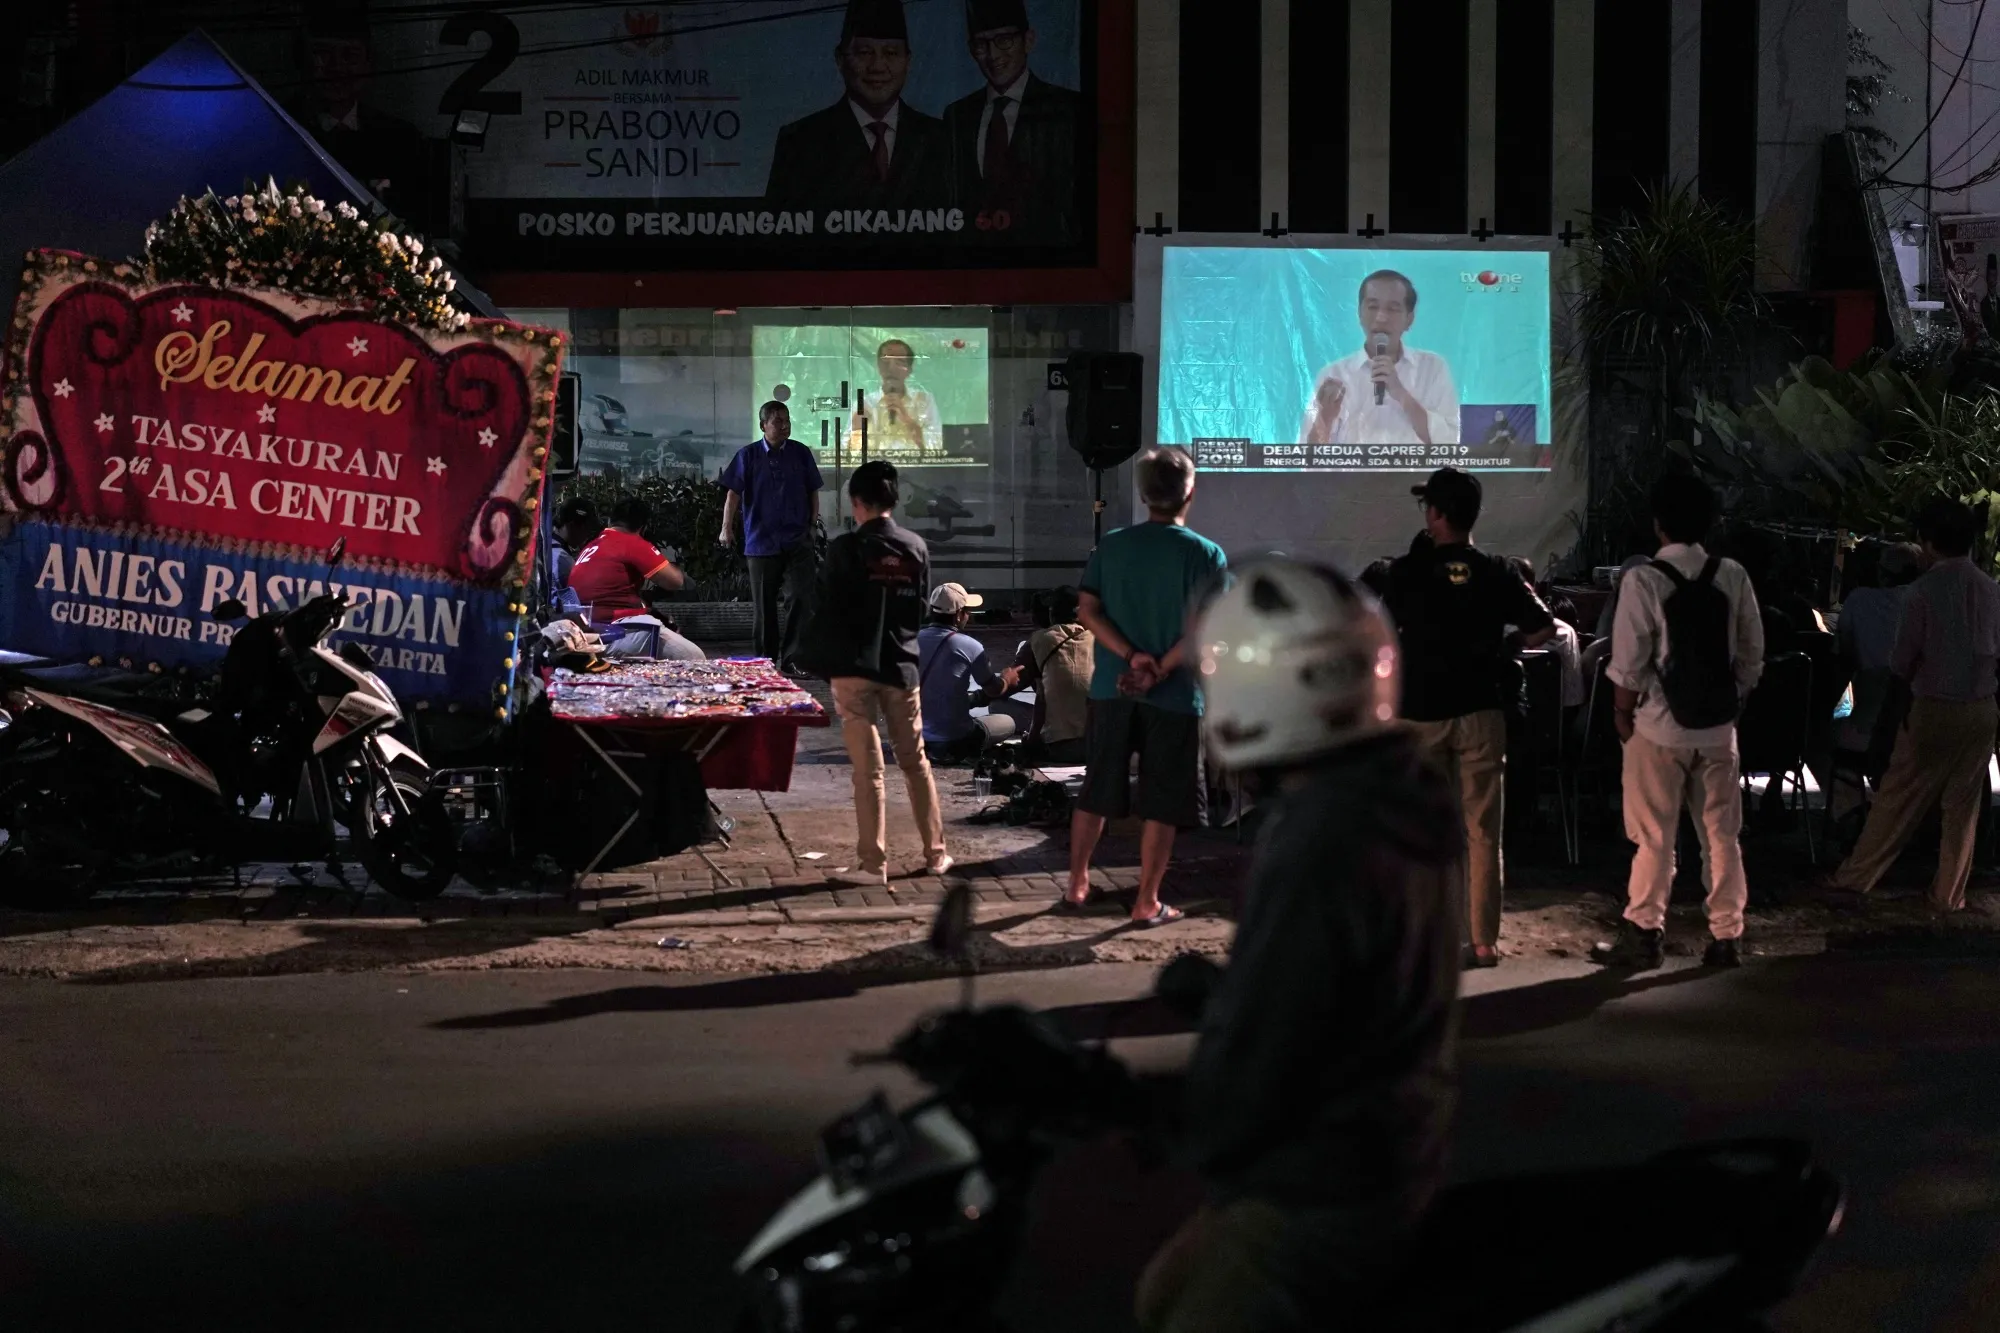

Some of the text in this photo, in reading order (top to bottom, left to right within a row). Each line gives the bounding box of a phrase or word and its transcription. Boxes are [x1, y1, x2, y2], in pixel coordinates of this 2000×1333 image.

[438, 11, 522, 115] 2
[575, 69, 710, 85] ADIL MAKMUR
[614, 93, 673, 104] BERSAMA
[544, 110, 741, 140] PRABOWO
[586, 147, 698, 177] SANDI
[518, 207, 1011, 236] POSKO PERJUANGAN CIKAJANG 60
[154, 320, 414, 415] Selamat
[131, 414, 402, 481] TASYAKURAN
[1197, 454, 1244, 465] 2019
[1198, 441, 1244, 449] DEBAT
[1263, 445, 1469, 456] DEBAT KEDUA CAPRES 2019
[1367, 457, 1390, 467] SDA
[1393, 458, 1402, 466] &
[1425, 457, 1511, 467] INFRASTRUKTUR
[148, 464, 238, 511] ASA
[250, 478, 422, 536] CENTER
[34, 542, 186, 609] ANIES
[51, 600, 193, 642] GUBERNUR
